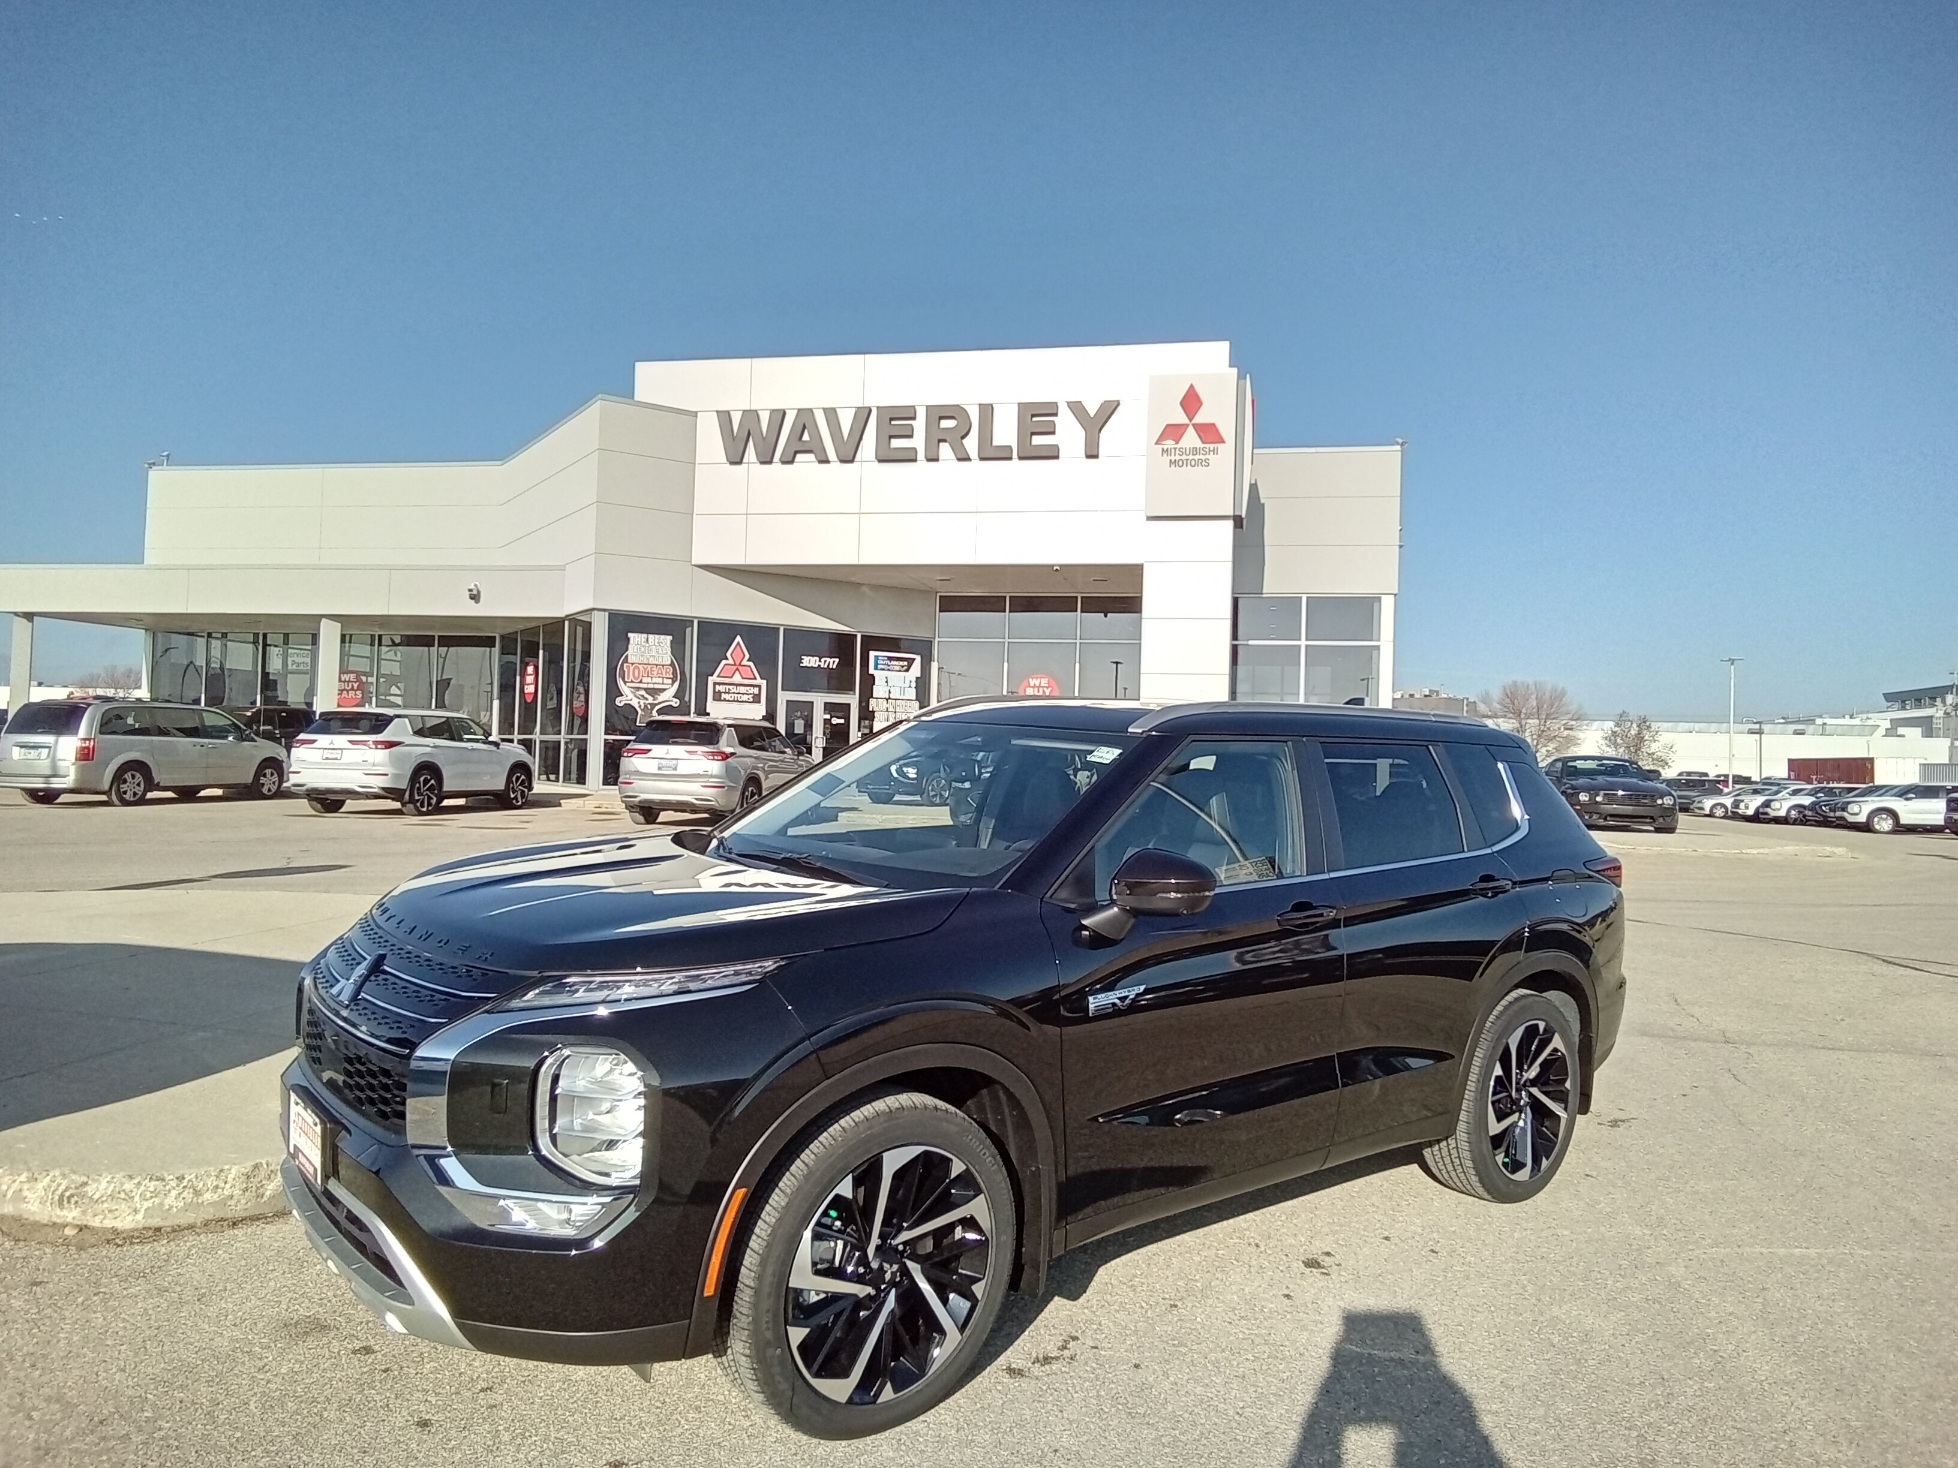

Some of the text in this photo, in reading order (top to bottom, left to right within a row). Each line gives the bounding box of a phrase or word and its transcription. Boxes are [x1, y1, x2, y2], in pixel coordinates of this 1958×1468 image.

[716, 400, 1120, 464] WAVERLEY
[1161, 446, 1218, 457] MITSUBISHI
[1169, 458, 1210, 468] MOTORS
[629, 633, 672, 648] THE BEST
[291, 660, 310, 668] Parts
[800, 656, 839, 669] 300-1717
[340, 673, 357, 682] WE
[624, 664, 642, 682] 10
[642, 665, 673, 678] YEAR
[338, 682, 360, 690] BUY
[1028, 677, 1049, 687] WE
[715, 684, 759, 694] MITSUBISHI
[1025, 687, 1053, 696] BUY
[721, 693, 753, 702] MOTORS
[869, 698, 919, 713] PLUG-IN HYBRID
